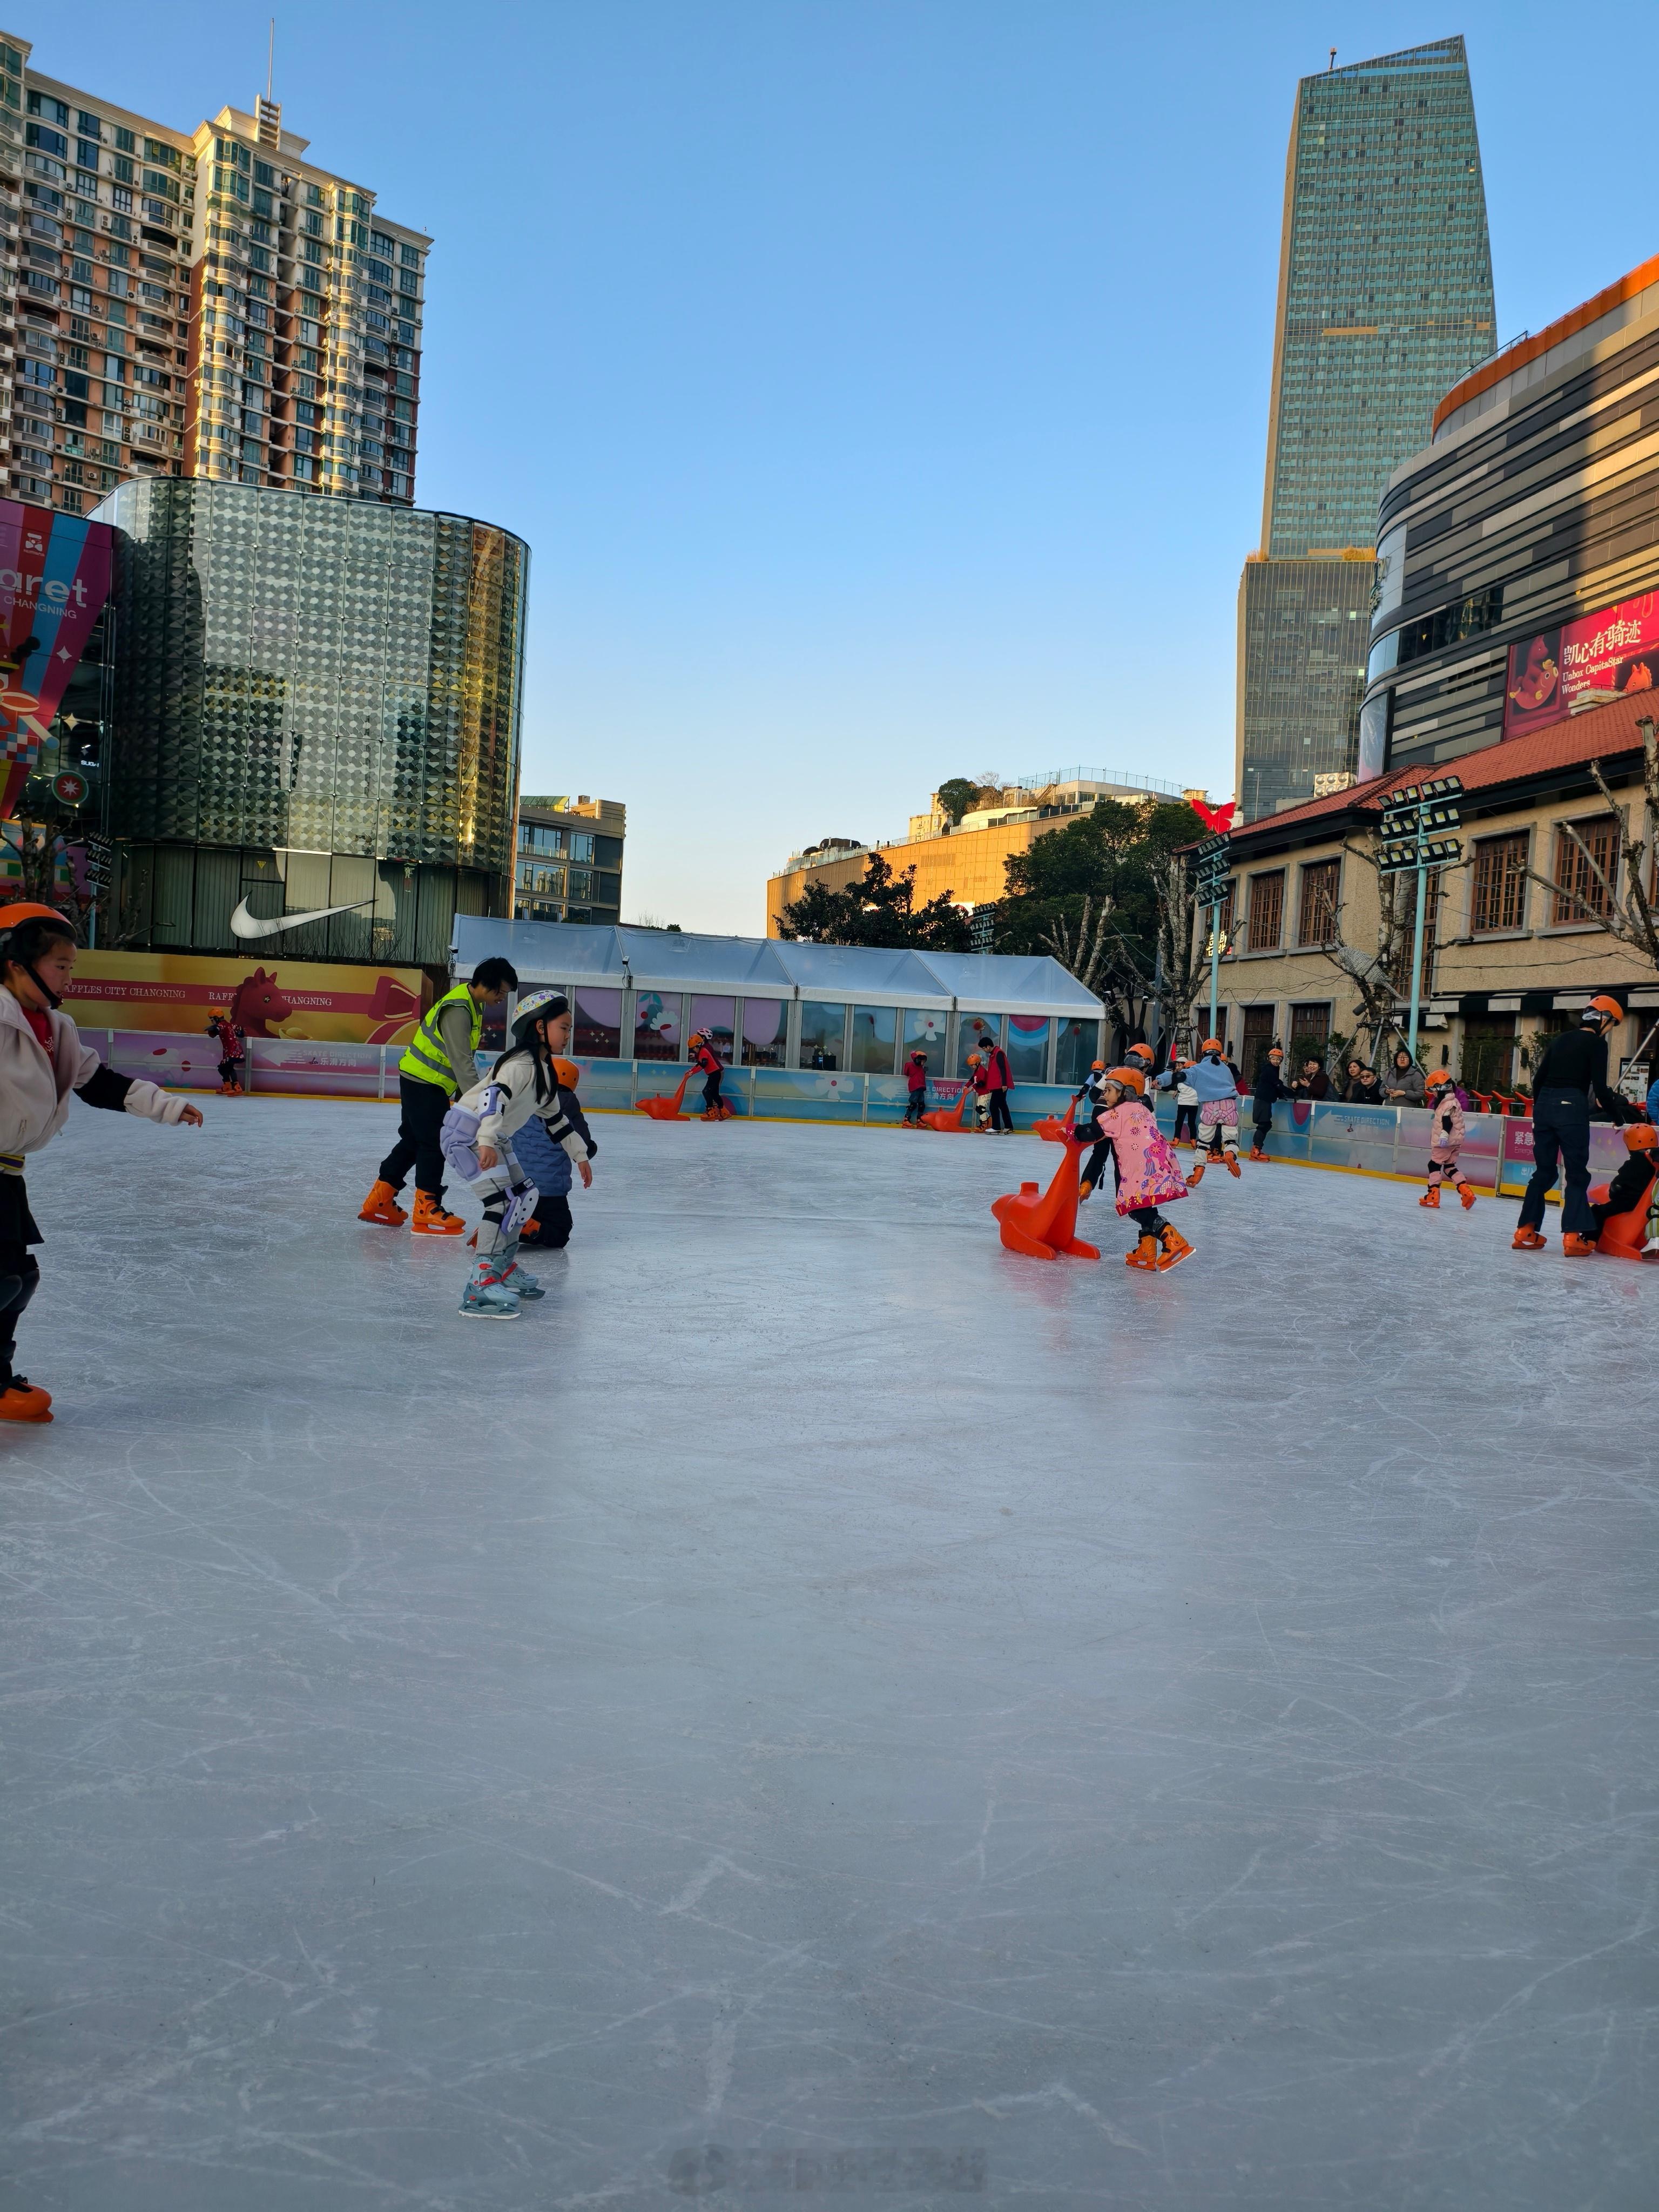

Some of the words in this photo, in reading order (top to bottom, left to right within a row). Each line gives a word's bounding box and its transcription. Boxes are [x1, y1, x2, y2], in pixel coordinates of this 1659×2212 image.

[4, 596, 77, 619] CHANGNING
[1564, 619, 1642, 666] 凯心有骑迹
[1562, 670, 1583, 682] Unbox
[1586, 656, 1623, 675] CapitaStar
[1562, 679, 1590, 694] Wonders
[64, 984, 102, 994] AFFLES
[105, 986, 127, 995] CITY
[130, 988, 186, 998] CHANGNING
[208, 992, 237, 1001] RAFF
[329, 1051, 372, 1059] DIRECTION
[1344, 1115, 1360, 1123] SKATE
[1360, 1116, 1390, 1126] DIRECTION
[1514, 1131, 1534, 1146] 紧急
